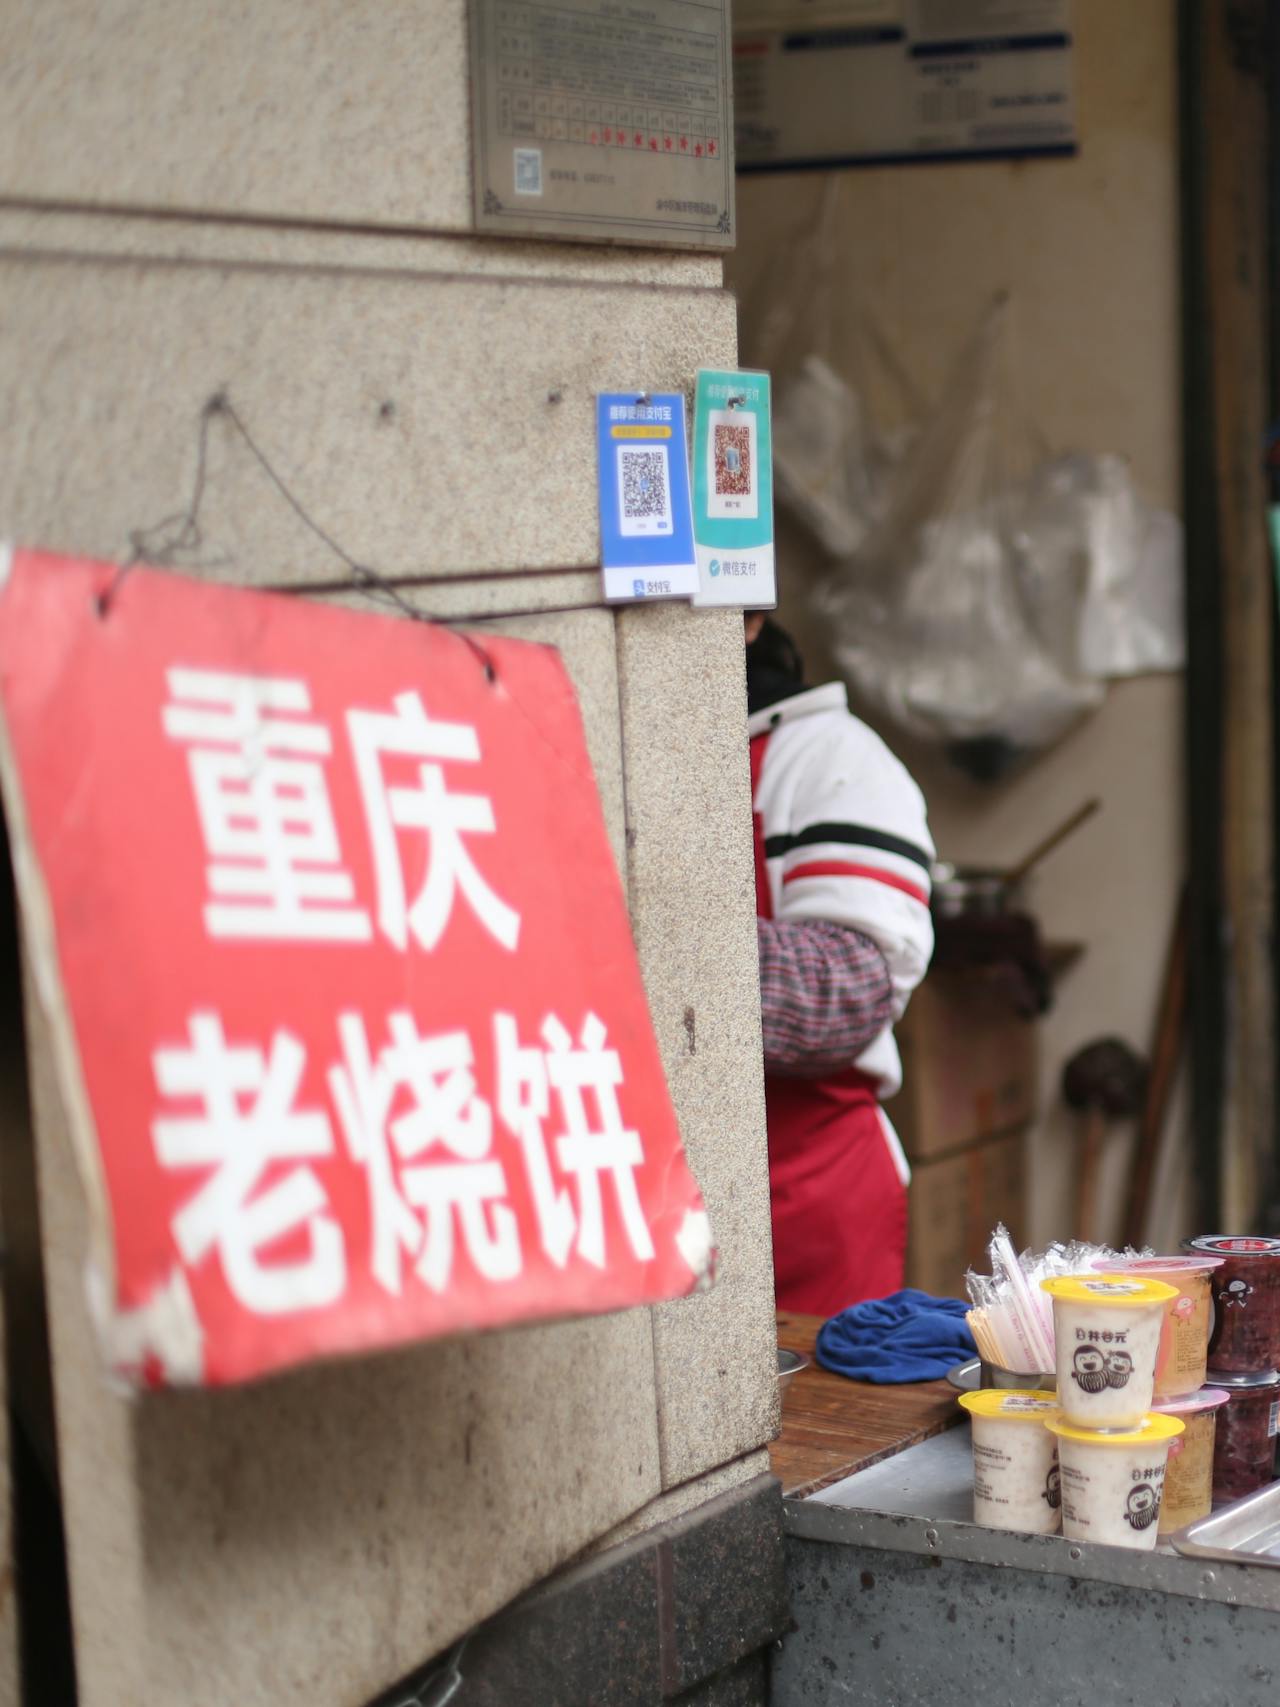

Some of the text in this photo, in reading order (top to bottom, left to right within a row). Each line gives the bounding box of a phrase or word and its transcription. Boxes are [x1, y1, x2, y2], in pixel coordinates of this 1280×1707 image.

[609, 404, 672, 422] 推荐使用支付宝
[722, 561, 757, 577] 微信支付
[646, 580, 672, 594] 支付宝
[163, 666, 522, 953] 重庆
[152, 1009, 655, 1316] 老烧饼
